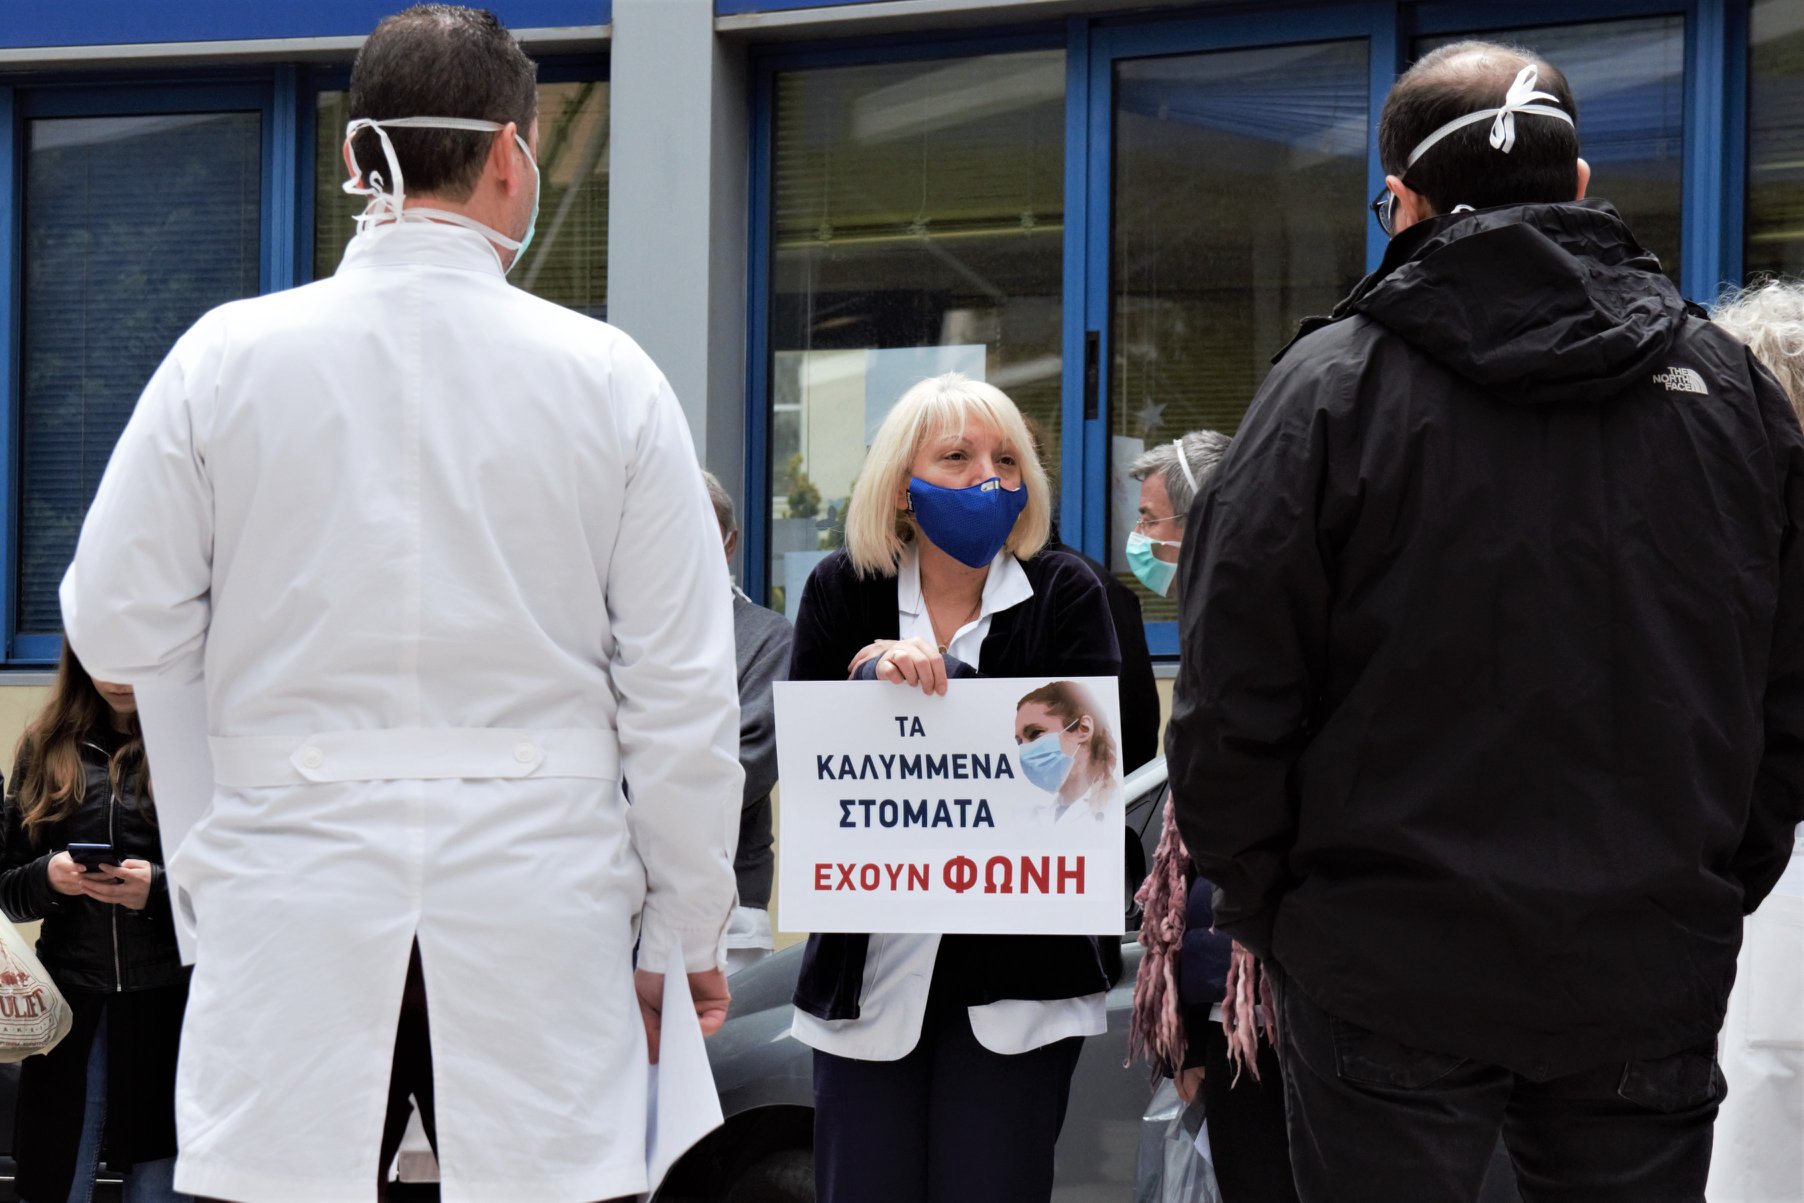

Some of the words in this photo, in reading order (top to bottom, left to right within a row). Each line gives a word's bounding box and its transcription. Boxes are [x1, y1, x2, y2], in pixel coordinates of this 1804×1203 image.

[1652, 373, 1690, 384] NORTH
[1667, 366, 1688, 375] THE
[1665, 382, 1692, 391] FACE
[895, 716, 926, 737] ΤΑ
[816, 753, 1015, 780] ΚΑΛΥΜΜΕΝΑ
[839, 799, 995, 828] ΣΤΟΜΑΤΑ
[814, 863, 930, 891] ΕΧΟΥΝ
[942, 855, 1086, 894] ΦΩΝΗ
